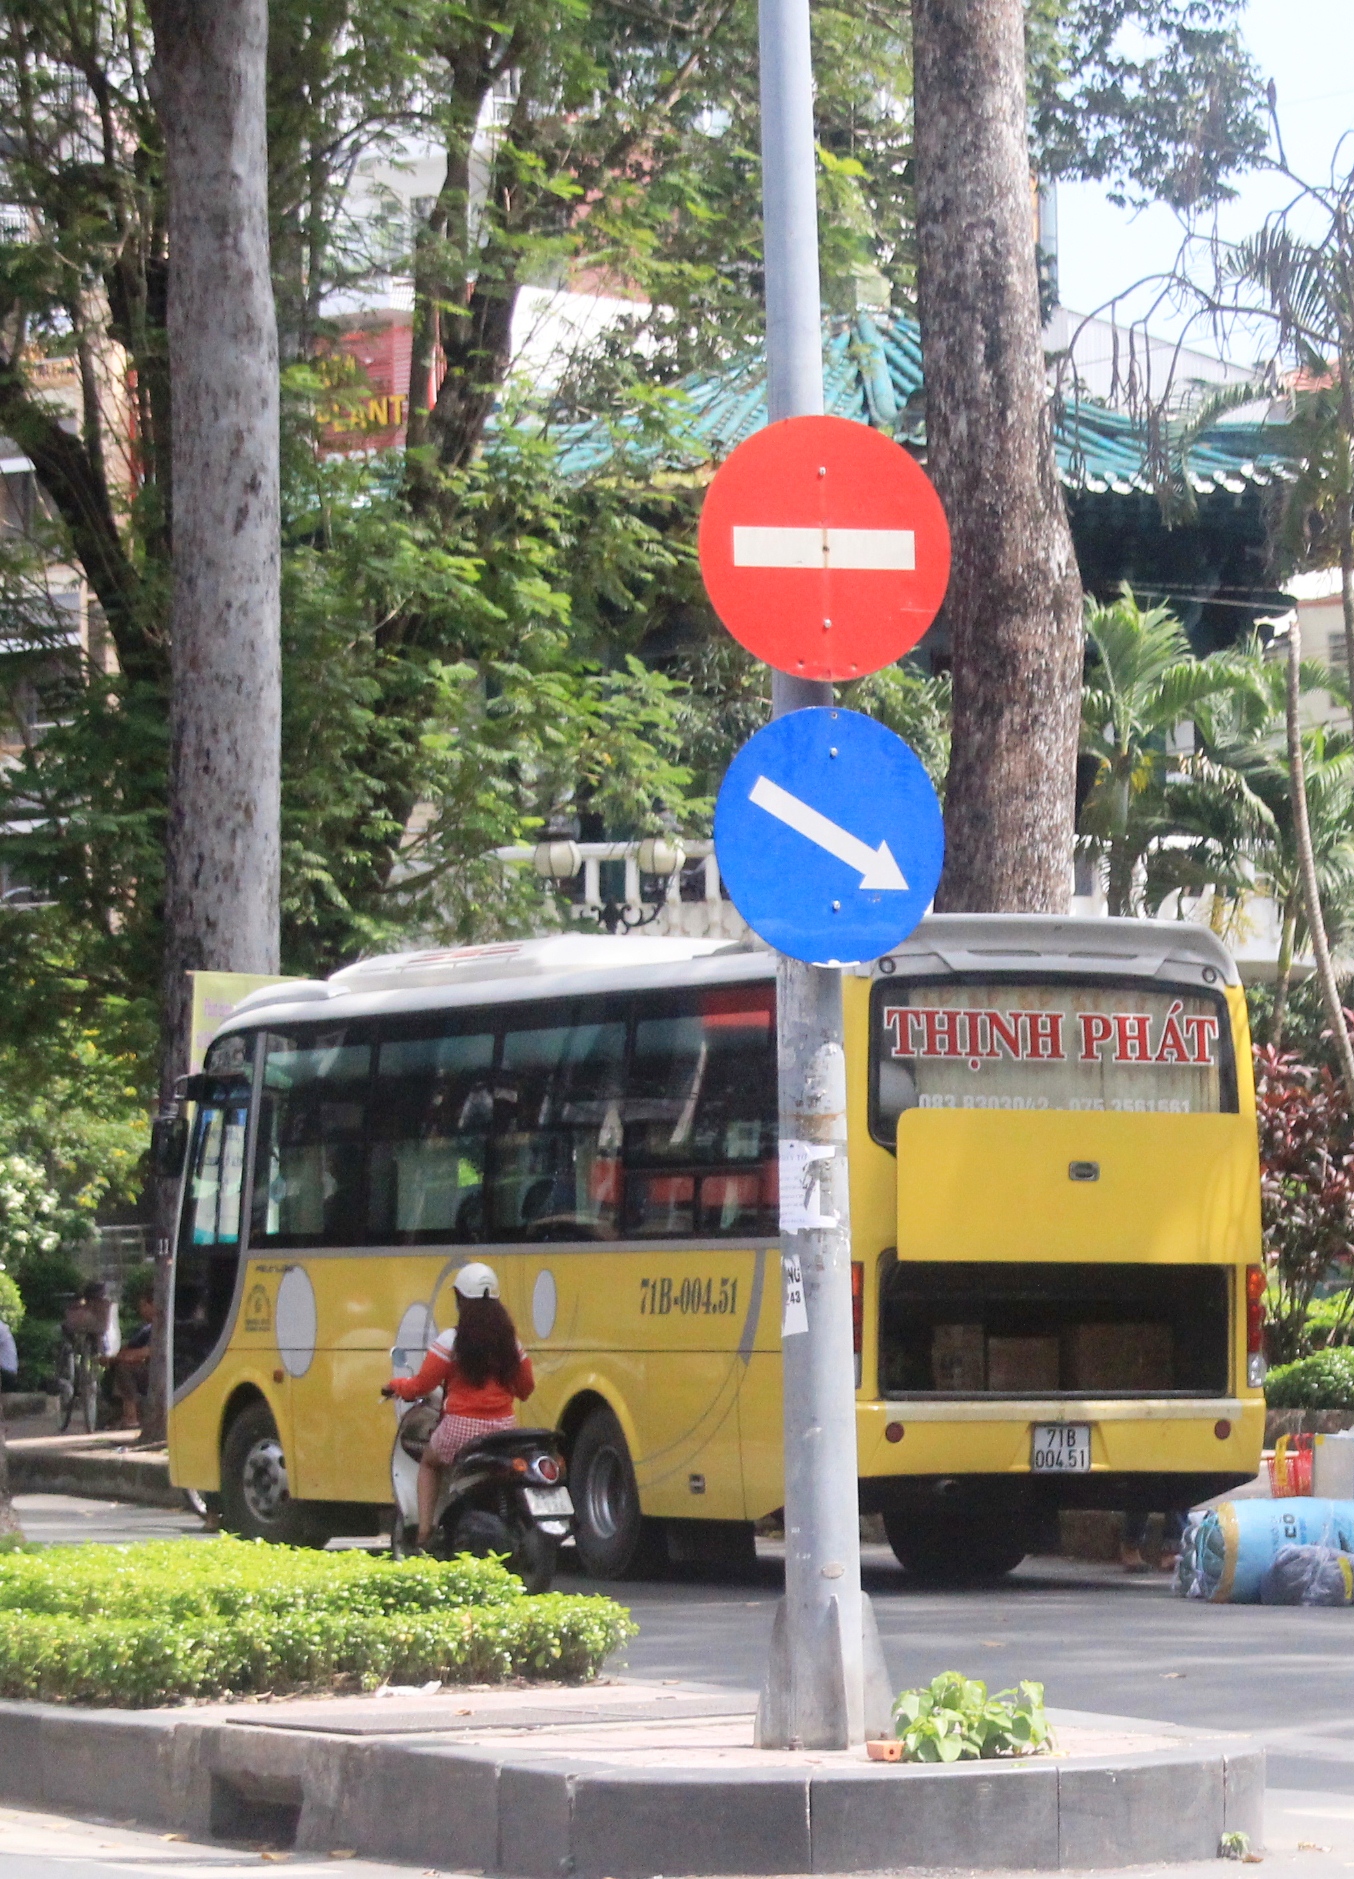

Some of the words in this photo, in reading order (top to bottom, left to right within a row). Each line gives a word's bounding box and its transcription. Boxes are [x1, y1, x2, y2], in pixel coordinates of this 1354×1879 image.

[884, 1006, 1067, 1071] THỊNH
[1078, 1000, 1219, 1065] PHÁT
[641, 1277, 738, 1315] 71B-004.51
[1047, 1429, 1076, 1448] 71B
